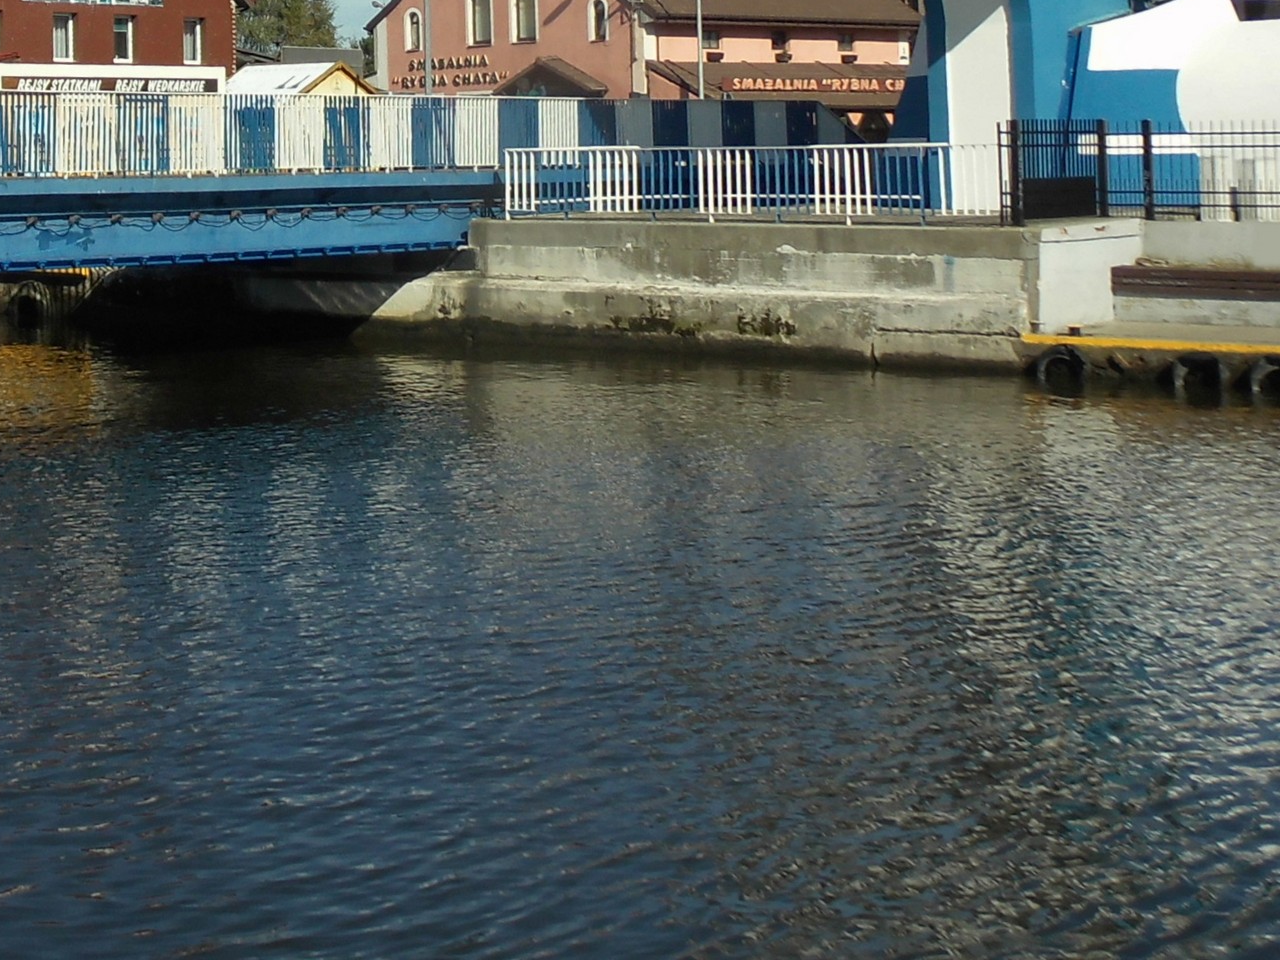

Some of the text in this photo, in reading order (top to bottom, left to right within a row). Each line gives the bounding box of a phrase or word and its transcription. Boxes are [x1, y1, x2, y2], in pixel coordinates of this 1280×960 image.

[17, 78, 50, 91] REJSY
[50, 78, 102, 91] STATKAMI
[115, 79, 145, 91] REJSY
